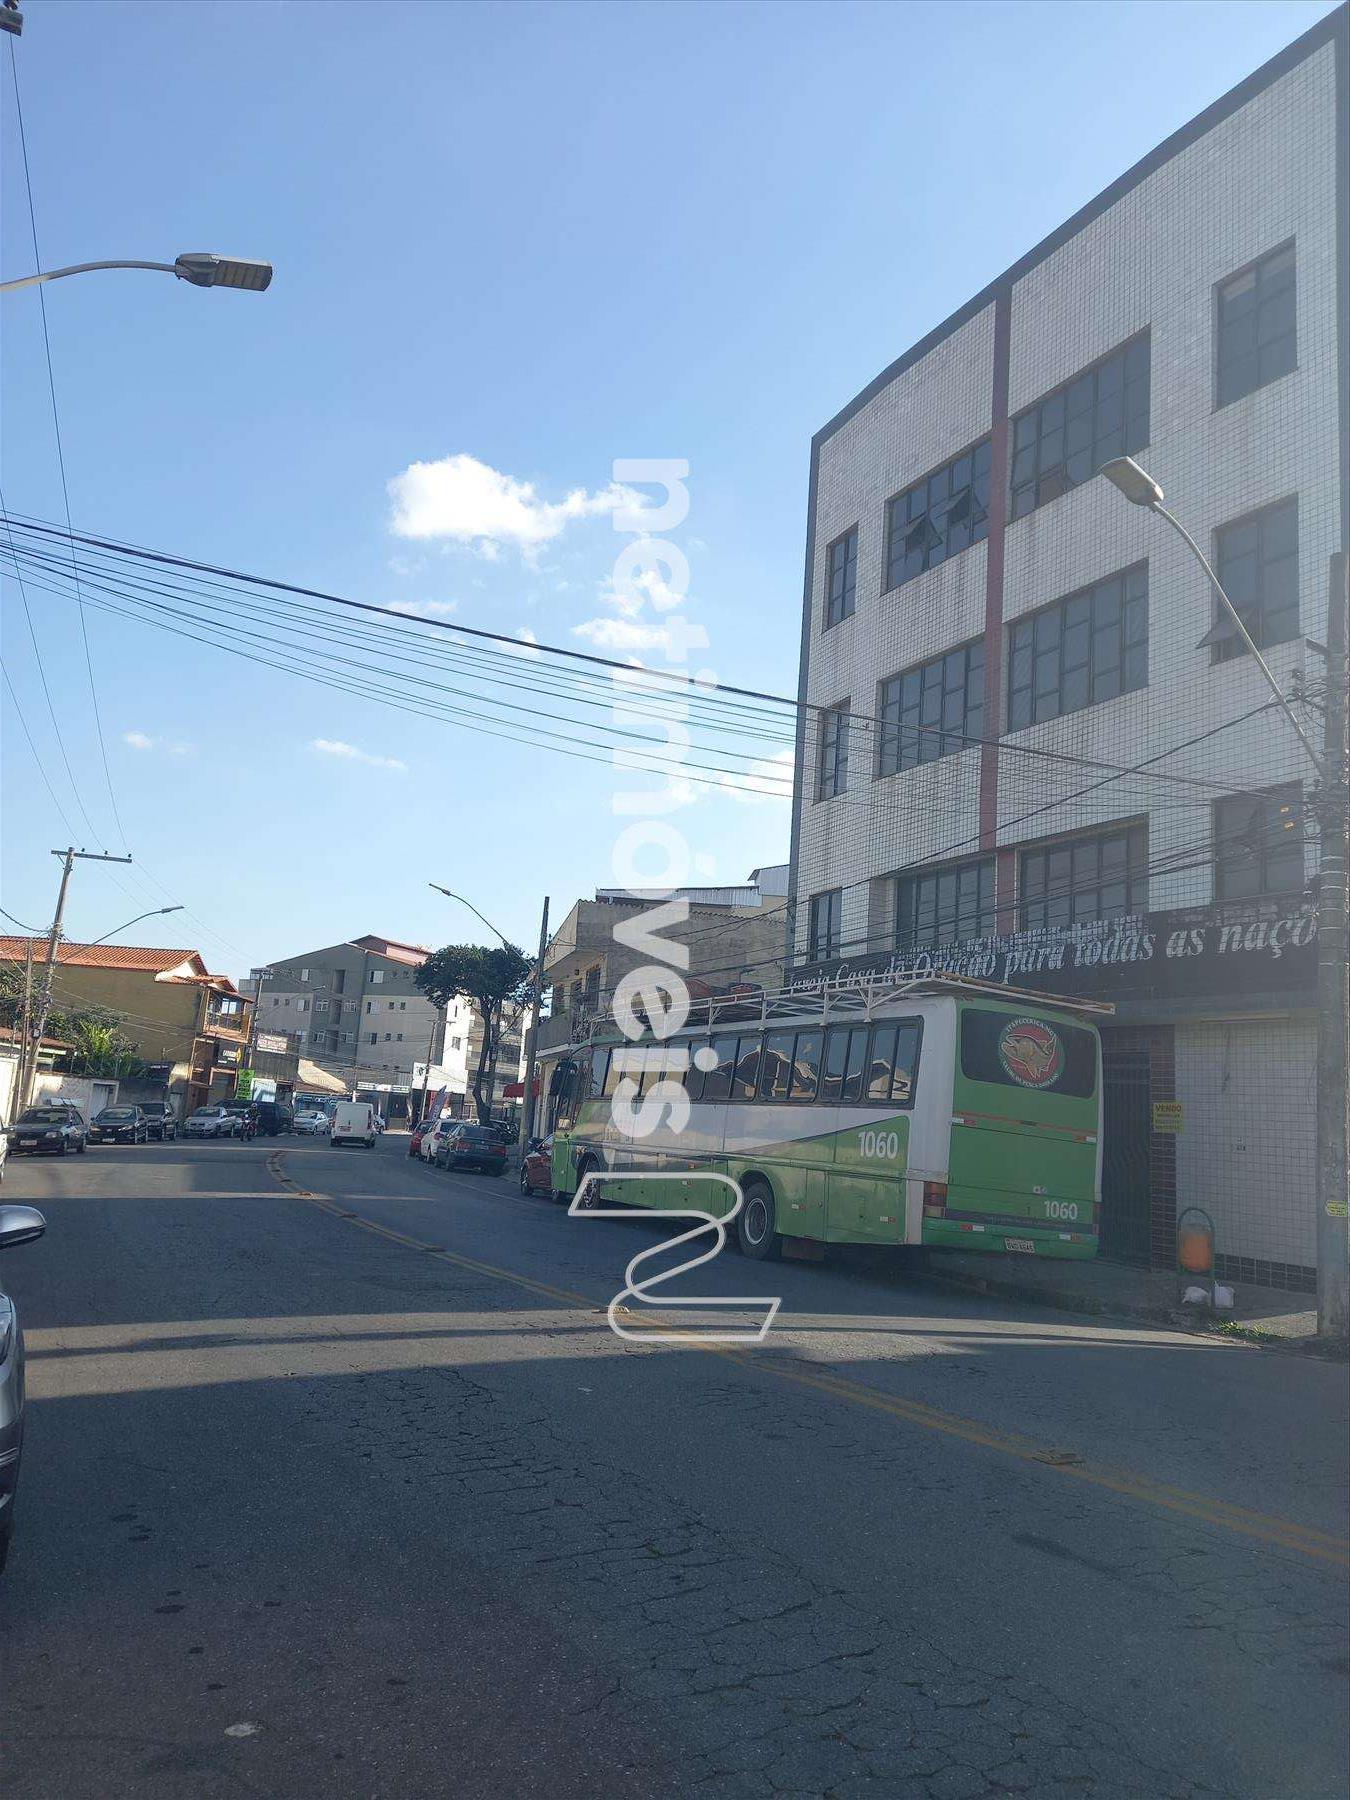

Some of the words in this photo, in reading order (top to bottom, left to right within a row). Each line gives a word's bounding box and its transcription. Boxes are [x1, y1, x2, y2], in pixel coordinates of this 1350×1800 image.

[1003, 942, 1065, 984] para
[1073, 925, 1155, 967] todas
[1166, 926, 1206, 958] as
[858, 1131, 898, 1160] 1060
[1044, 1200, 1078, 1220] 1060
